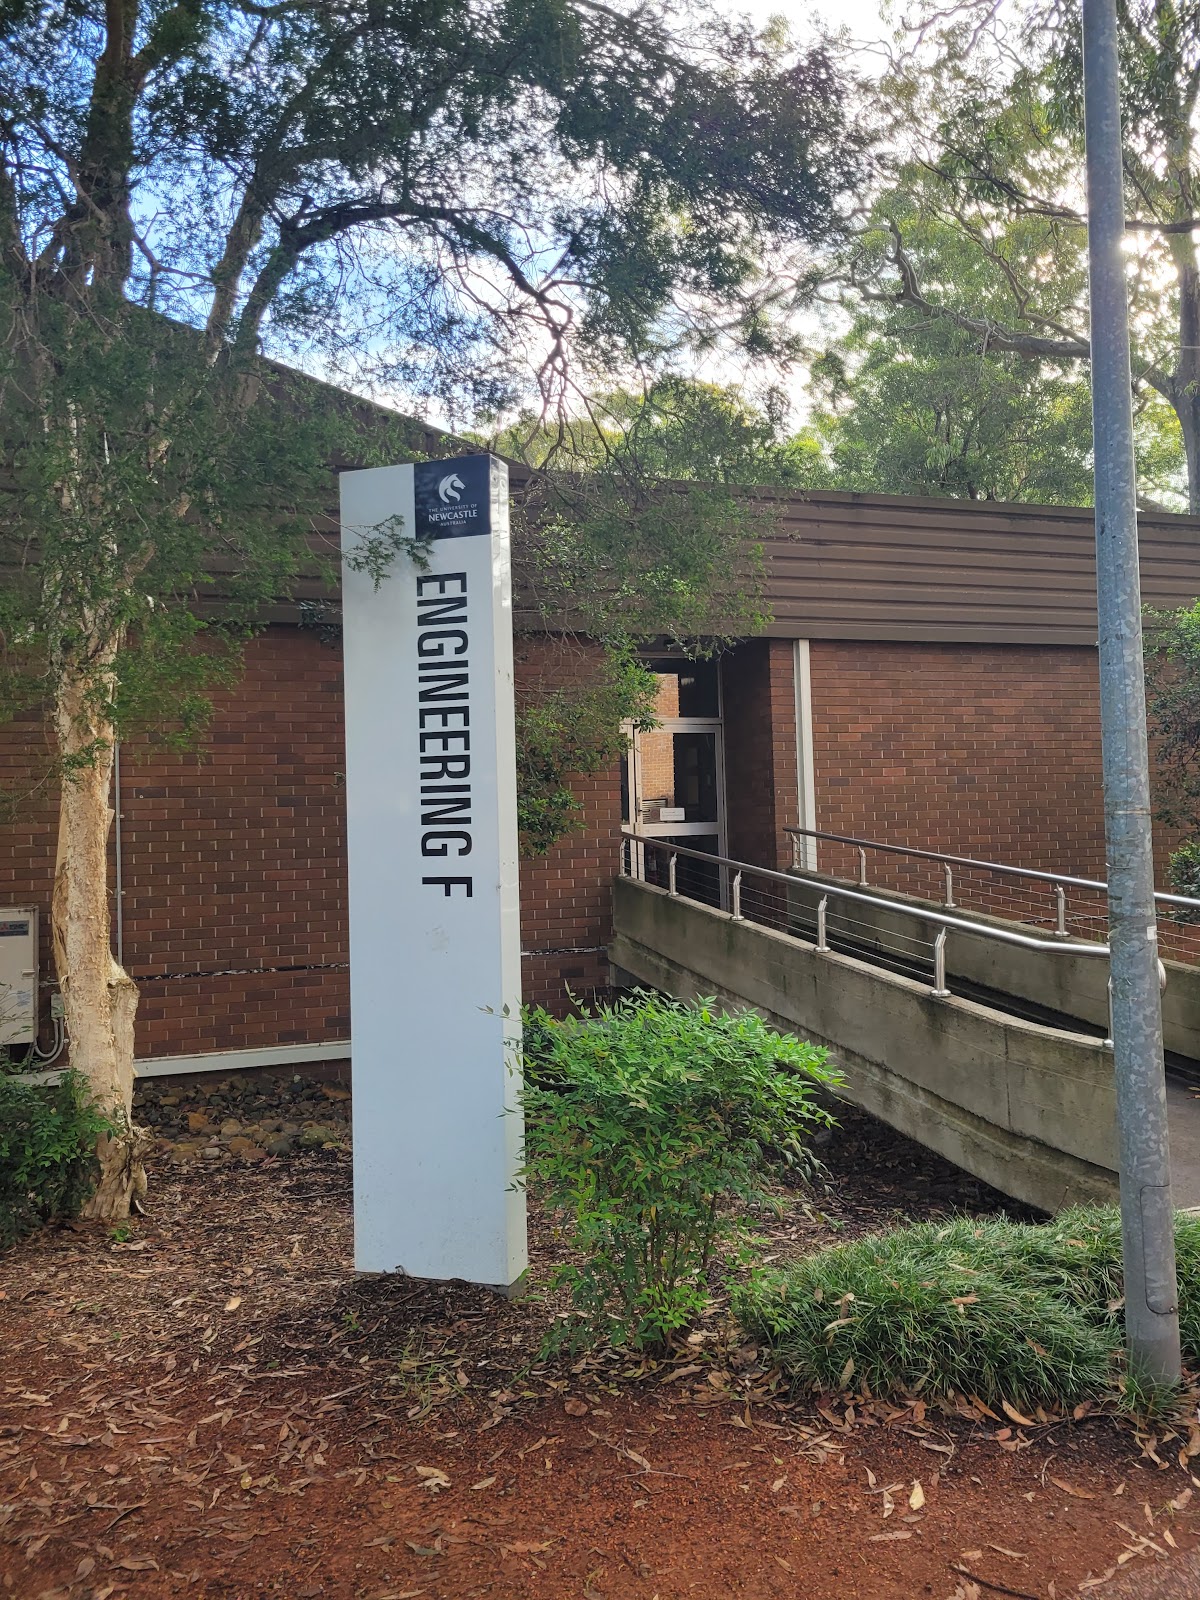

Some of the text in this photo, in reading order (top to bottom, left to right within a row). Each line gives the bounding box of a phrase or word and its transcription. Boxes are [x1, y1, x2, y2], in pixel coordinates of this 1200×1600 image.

[440, 504, 469, 512] UNIVERSITY
[428, 509, 478, 522] NEWCASTLE
[416, 571, 473, 898] ENGINEERING F
